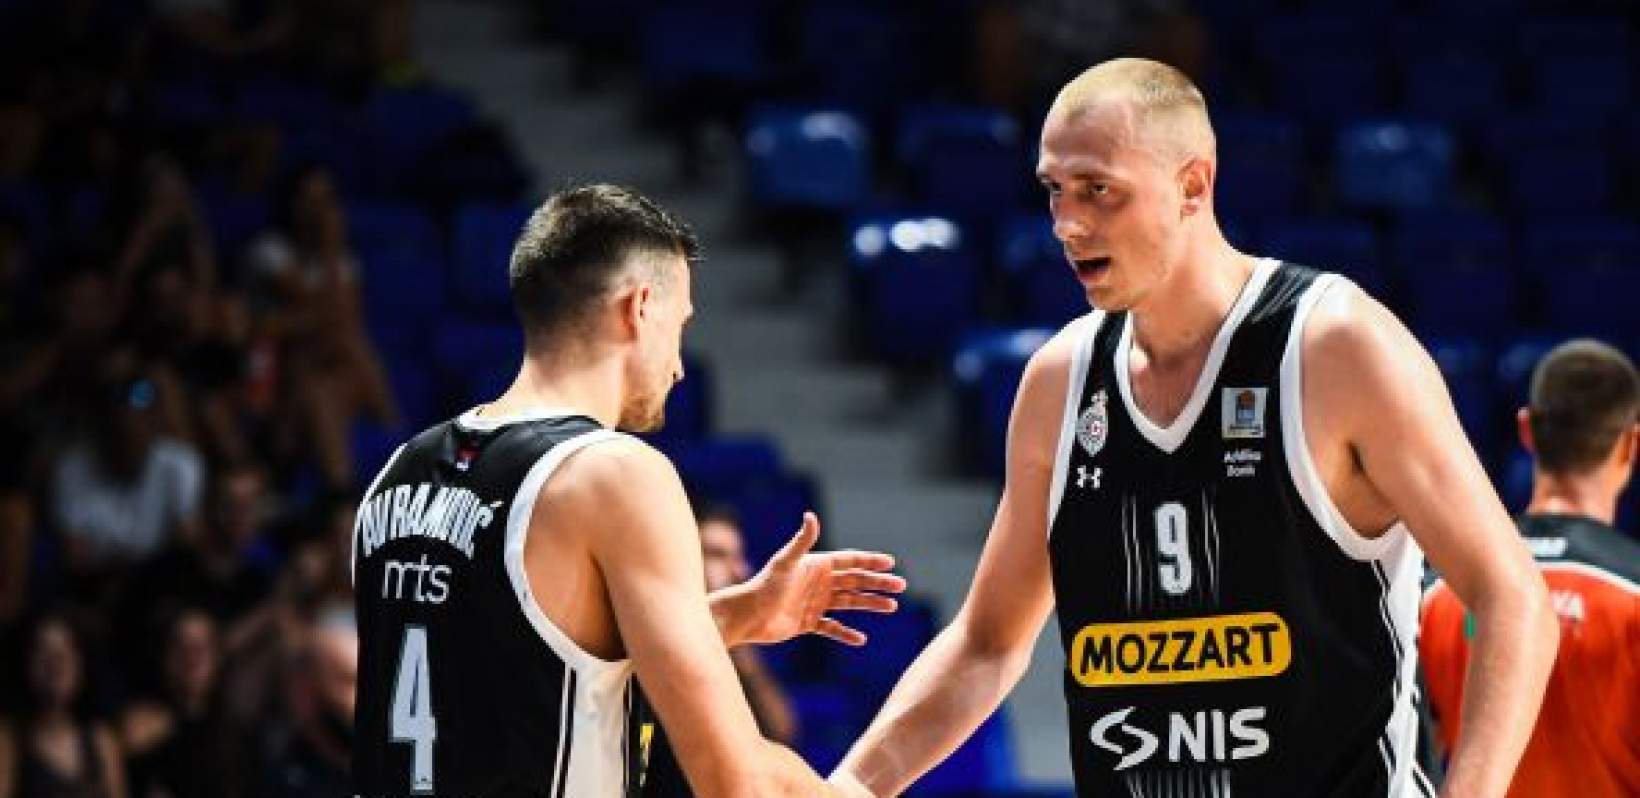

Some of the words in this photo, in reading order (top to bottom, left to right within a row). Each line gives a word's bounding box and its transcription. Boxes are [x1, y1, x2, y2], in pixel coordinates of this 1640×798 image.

[1155, 501, 1192, 595] 9
[382, 554, 452, 604] mts
[1080, 622, 1281, 677] MOZZART
[390, 625, 437, 795] 4
[1168, 706, 1270, 763] NIS
